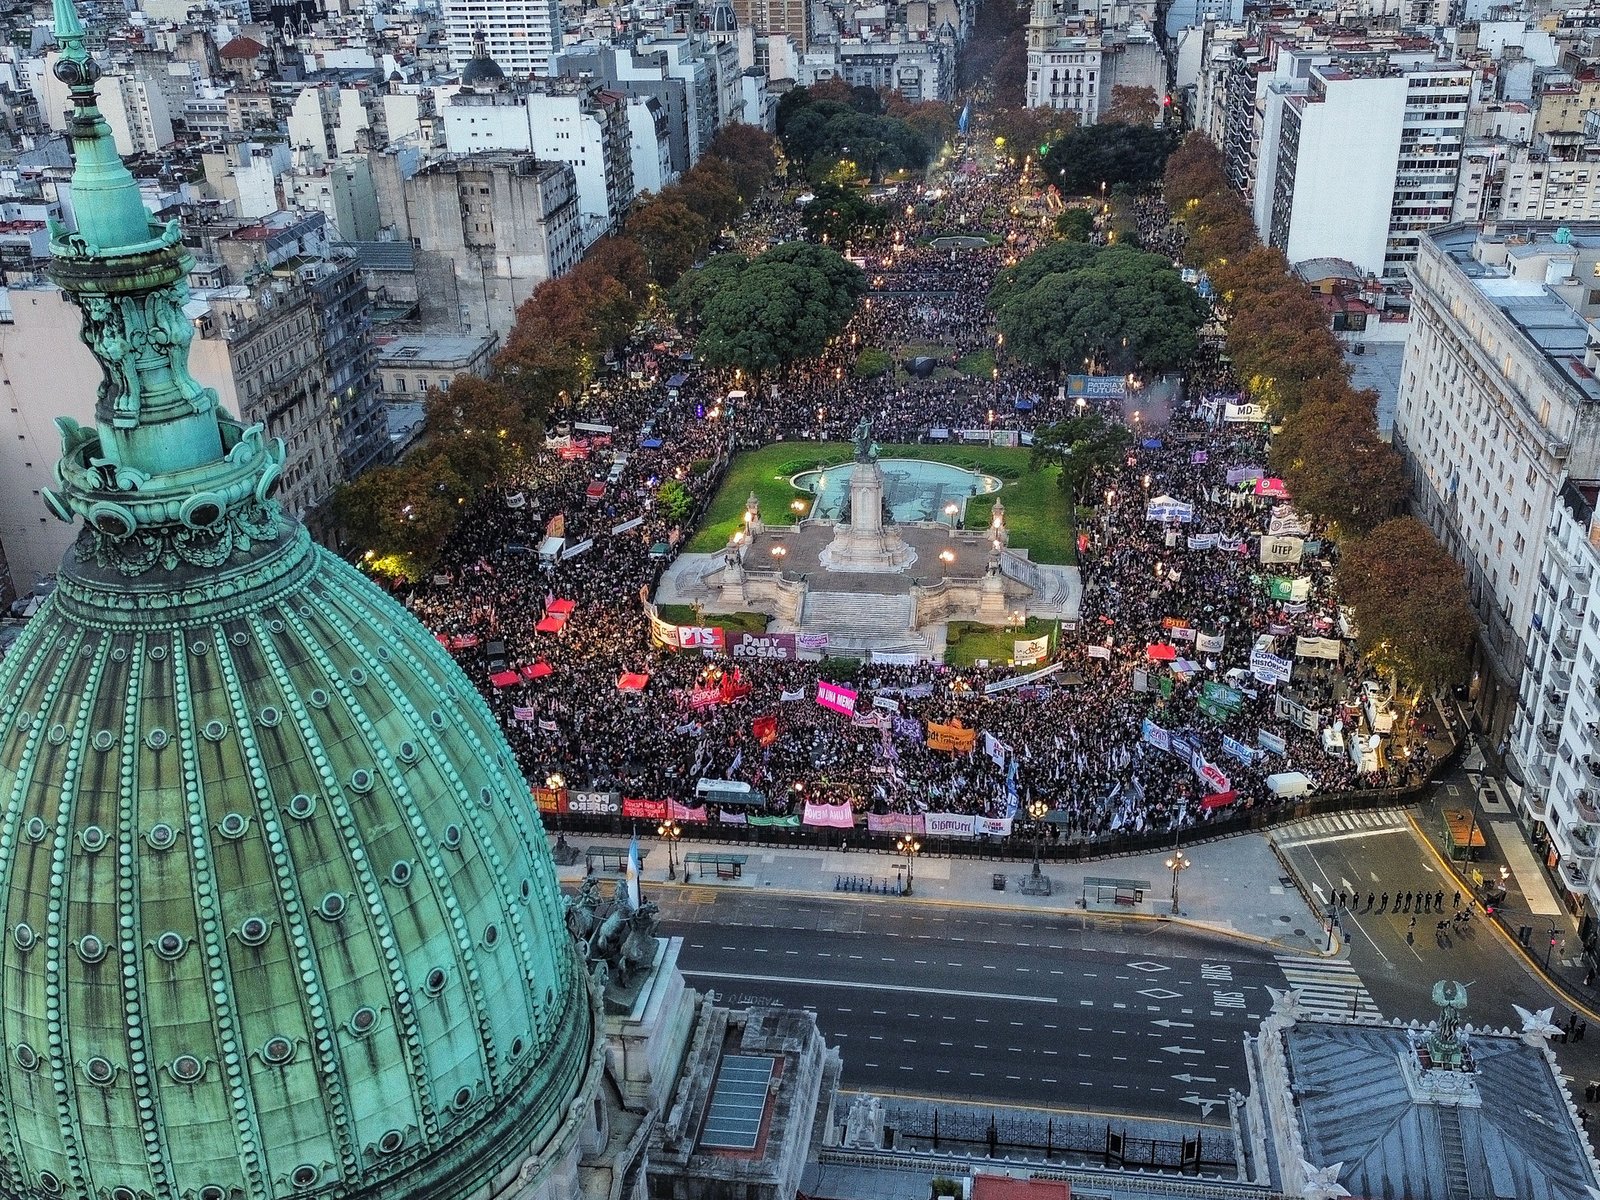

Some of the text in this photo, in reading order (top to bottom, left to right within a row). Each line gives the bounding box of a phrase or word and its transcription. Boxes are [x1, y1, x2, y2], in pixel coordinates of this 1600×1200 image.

[1271, 544, 1293, 555] UTEP
[1166, 618, 1186, 627] PSTU
[680, 626, 715, 645] PTS
[771, 637, 780, 647] Y
[733, 643, 788, 658] ROSAS
[1255, 652, 1289, 666] CONADU
[1251, 658, 1289, 675] HISTÓRICA
[818, 687, 826, 699] NI
[825, 690, 837, 704] UNA
[1280, 700, 1312, 727] UTE
[1200, 963, 1234, 980] BUS
[1213, 990, 1247, 1008] BUS
